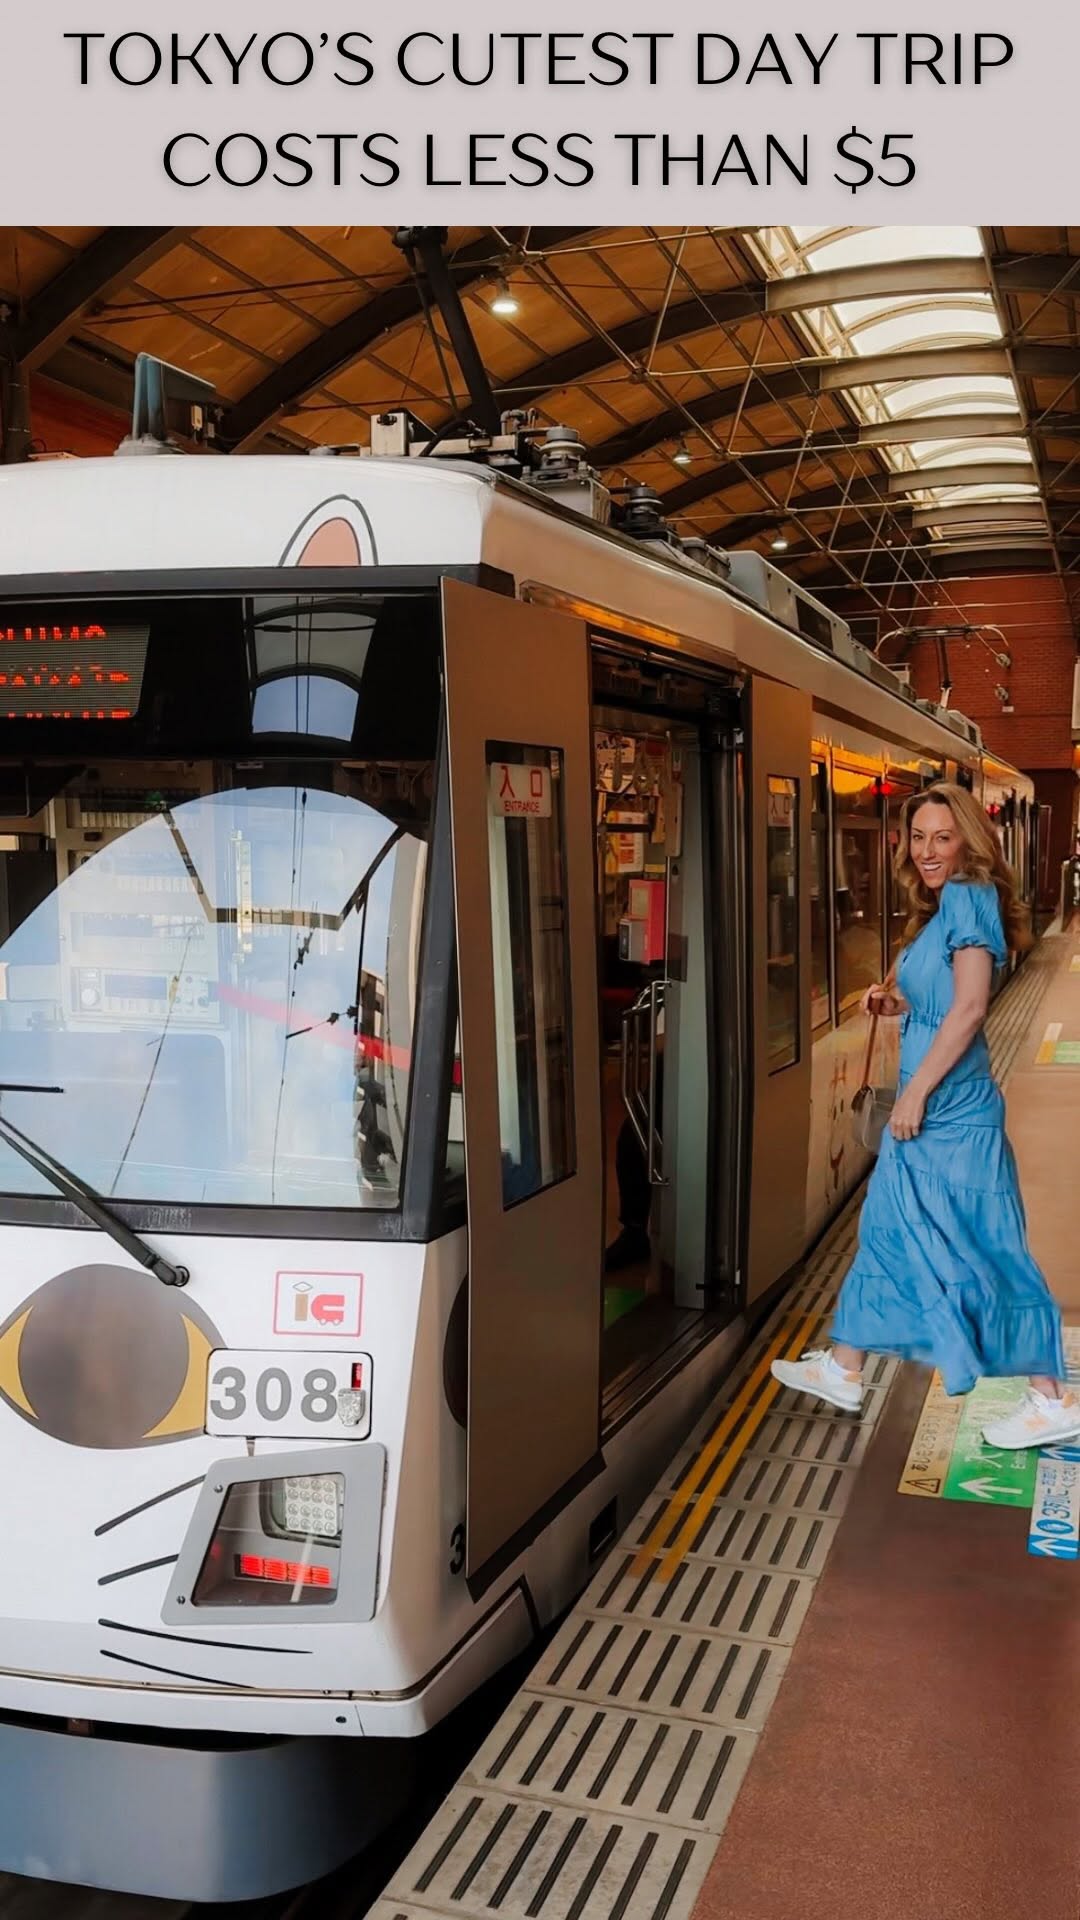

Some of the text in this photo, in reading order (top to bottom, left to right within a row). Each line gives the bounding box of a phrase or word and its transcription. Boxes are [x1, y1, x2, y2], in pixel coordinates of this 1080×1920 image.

[499, 765, 543, 798] 入口
[504, 800, 541, 813] ENTRANCE
[209, 1366, 338, 1423] 308
